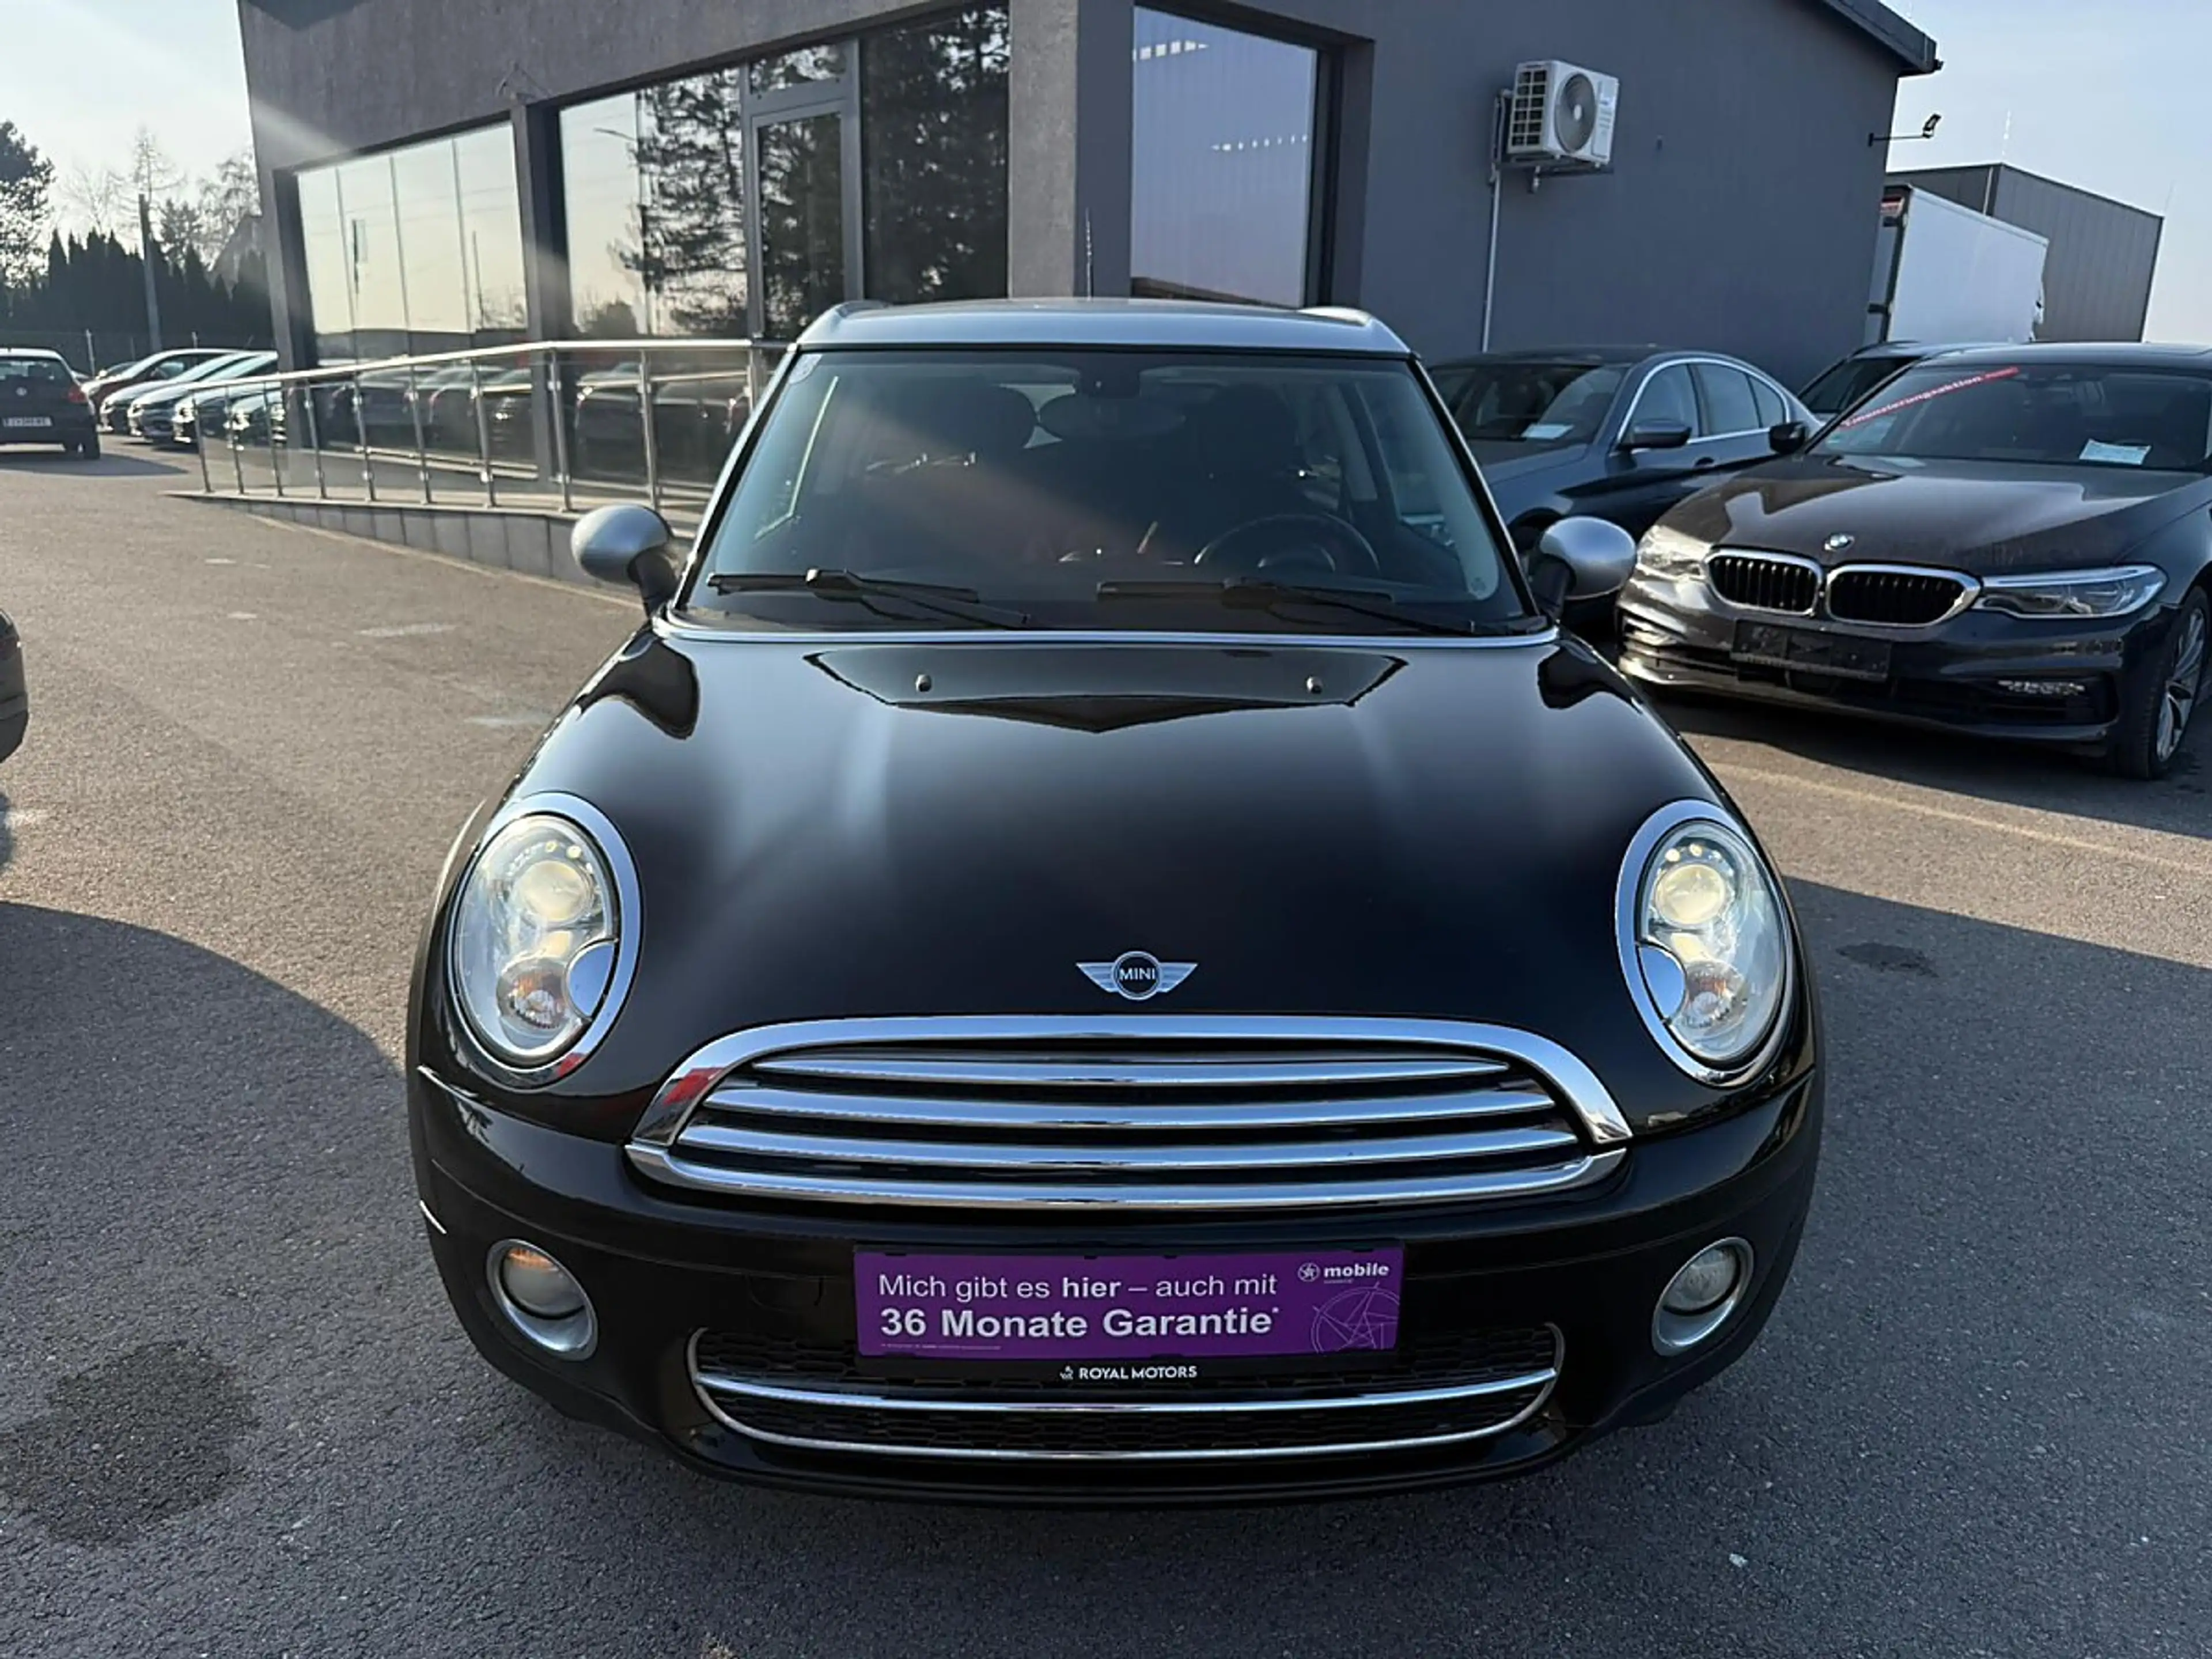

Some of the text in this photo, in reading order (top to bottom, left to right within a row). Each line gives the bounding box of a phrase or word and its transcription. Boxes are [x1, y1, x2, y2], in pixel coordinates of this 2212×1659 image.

[1119, 968, 1156, 980] MINI
[1323, 1263, 1390, 1278] mobile
[879, 1274, 946, 1297] Mich
[956, 1277, 1008, 1303] gibt
[1017, 1281, 1050, 1298] es
[1062, 1277, 1121, 1298] hier
[1156, 1275, 1224, 1297] auch
[1234, 1273, 1276, 1295] mit
[880, 1308, 927, 1336] 36
[941, 1309, 1088, 1338] Monate
[1079, 1365, 1198, 1380] ROYAL MOTORS
